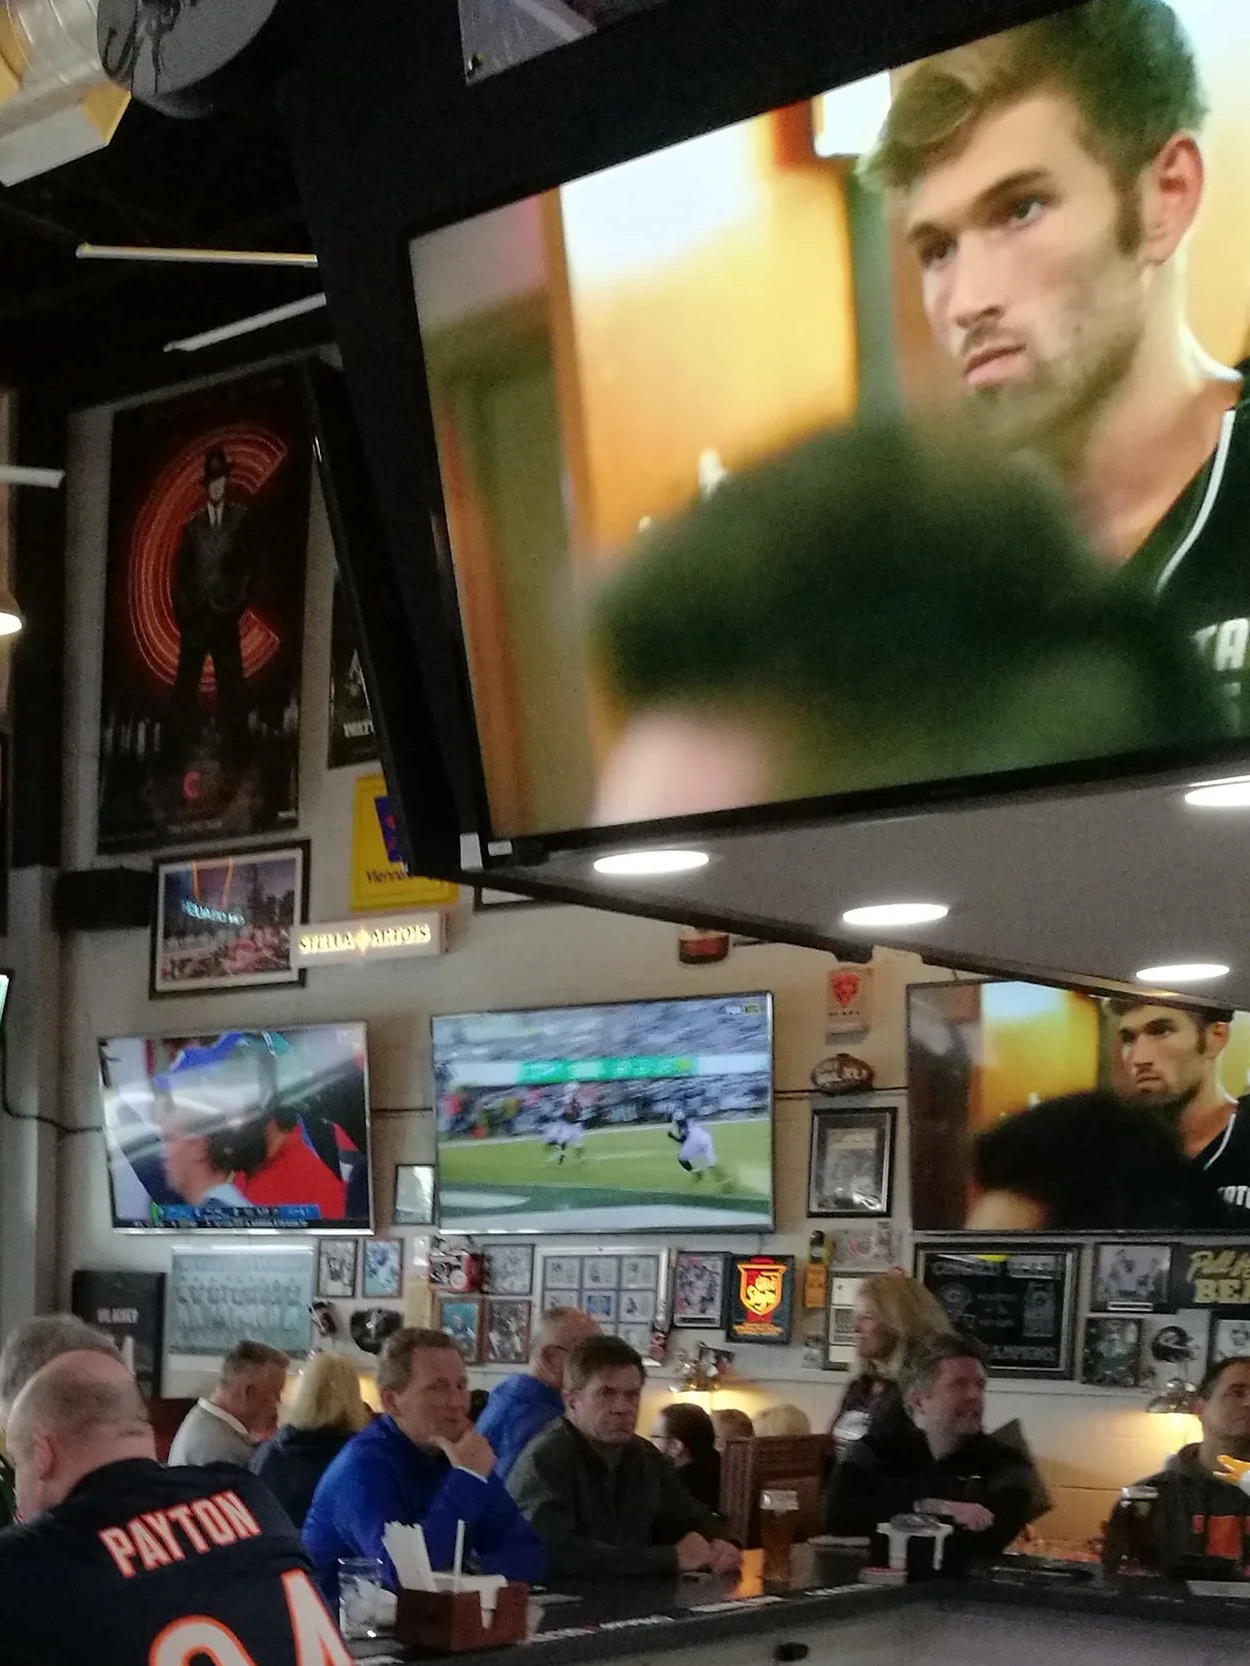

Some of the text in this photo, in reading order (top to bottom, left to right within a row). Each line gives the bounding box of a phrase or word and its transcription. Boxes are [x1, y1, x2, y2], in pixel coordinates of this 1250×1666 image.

[299, 924, 431, 954] STELLA ARTOIS
[97, 1489, 263, 1579] PAYTON
